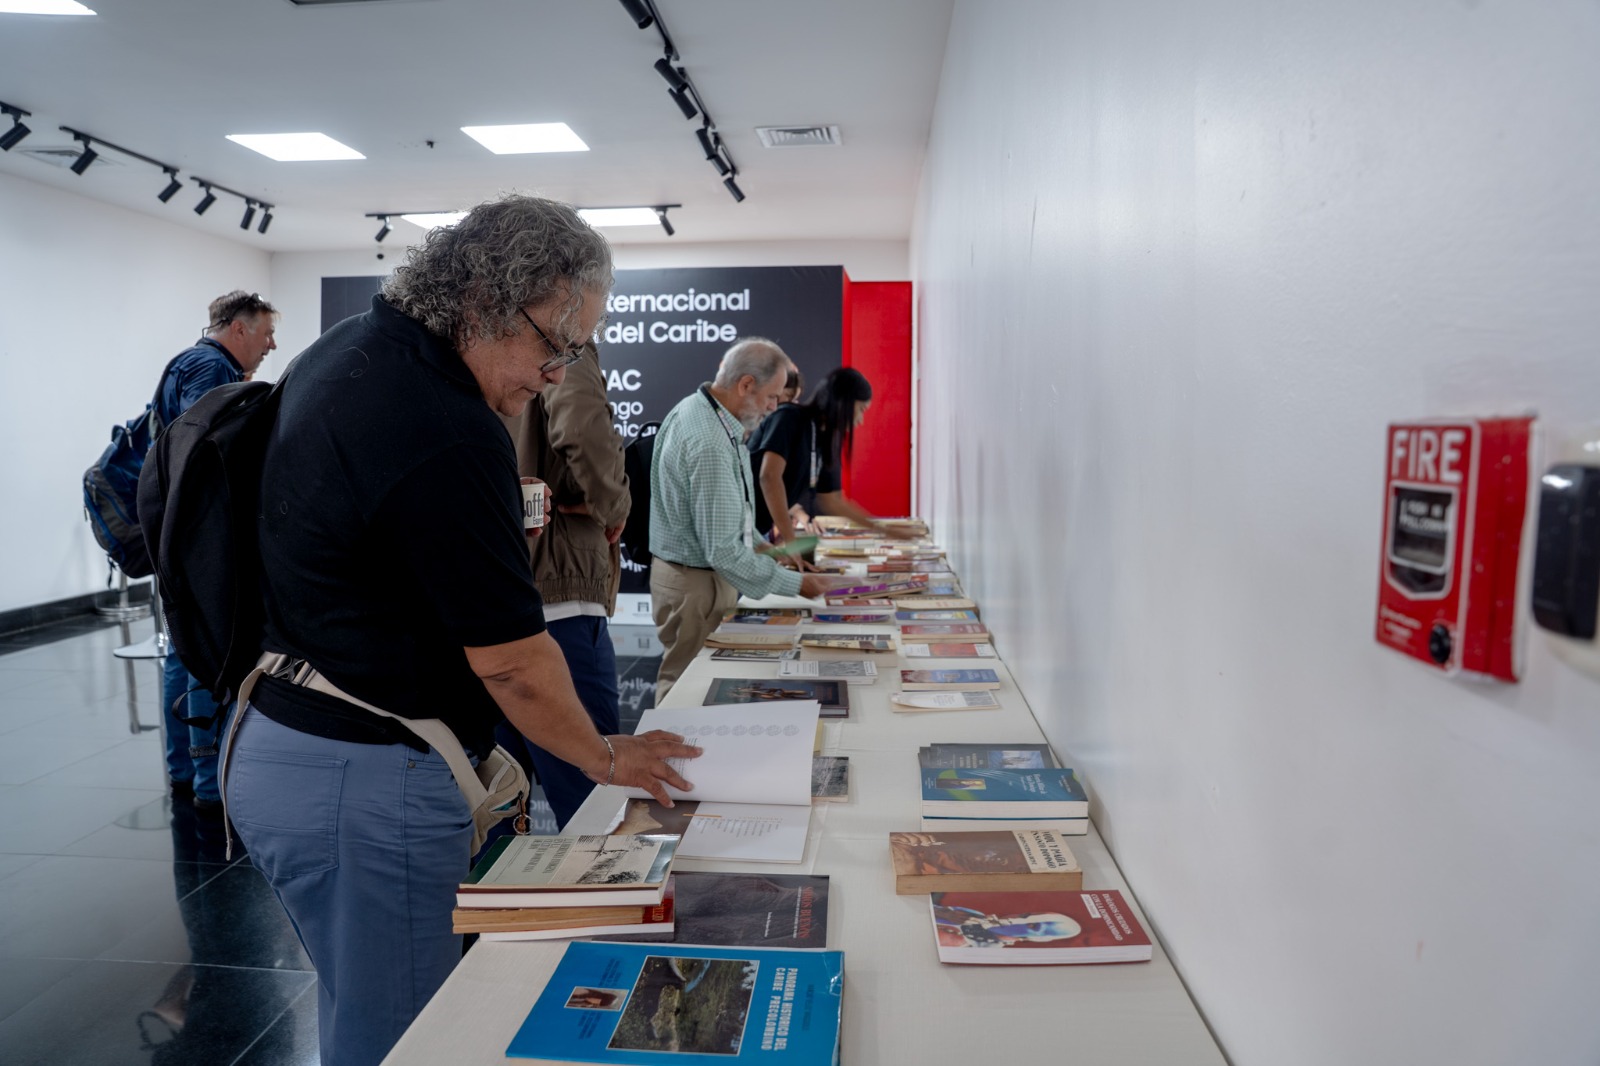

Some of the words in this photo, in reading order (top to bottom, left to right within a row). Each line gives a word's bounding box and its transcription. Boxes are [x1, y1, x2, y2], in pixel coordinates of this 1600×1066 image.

[605, 288, 750, 312] ternacional
[604, 321, 645, 344] del
[649, 319, 738, 343] Caribe
[609, 401, 644, 420] ngo
[1390, 429, 1467, 484] FIRE
[772, 967, 786, 991] CARIBE
[783, 967, 798, 1001] PANORAMA
[761, 995, 781, 1051] PRECOLOMBINO
[777, 1002, 793, 1036] HISTORICO
[773, 1037, 788, 1051] DEL
